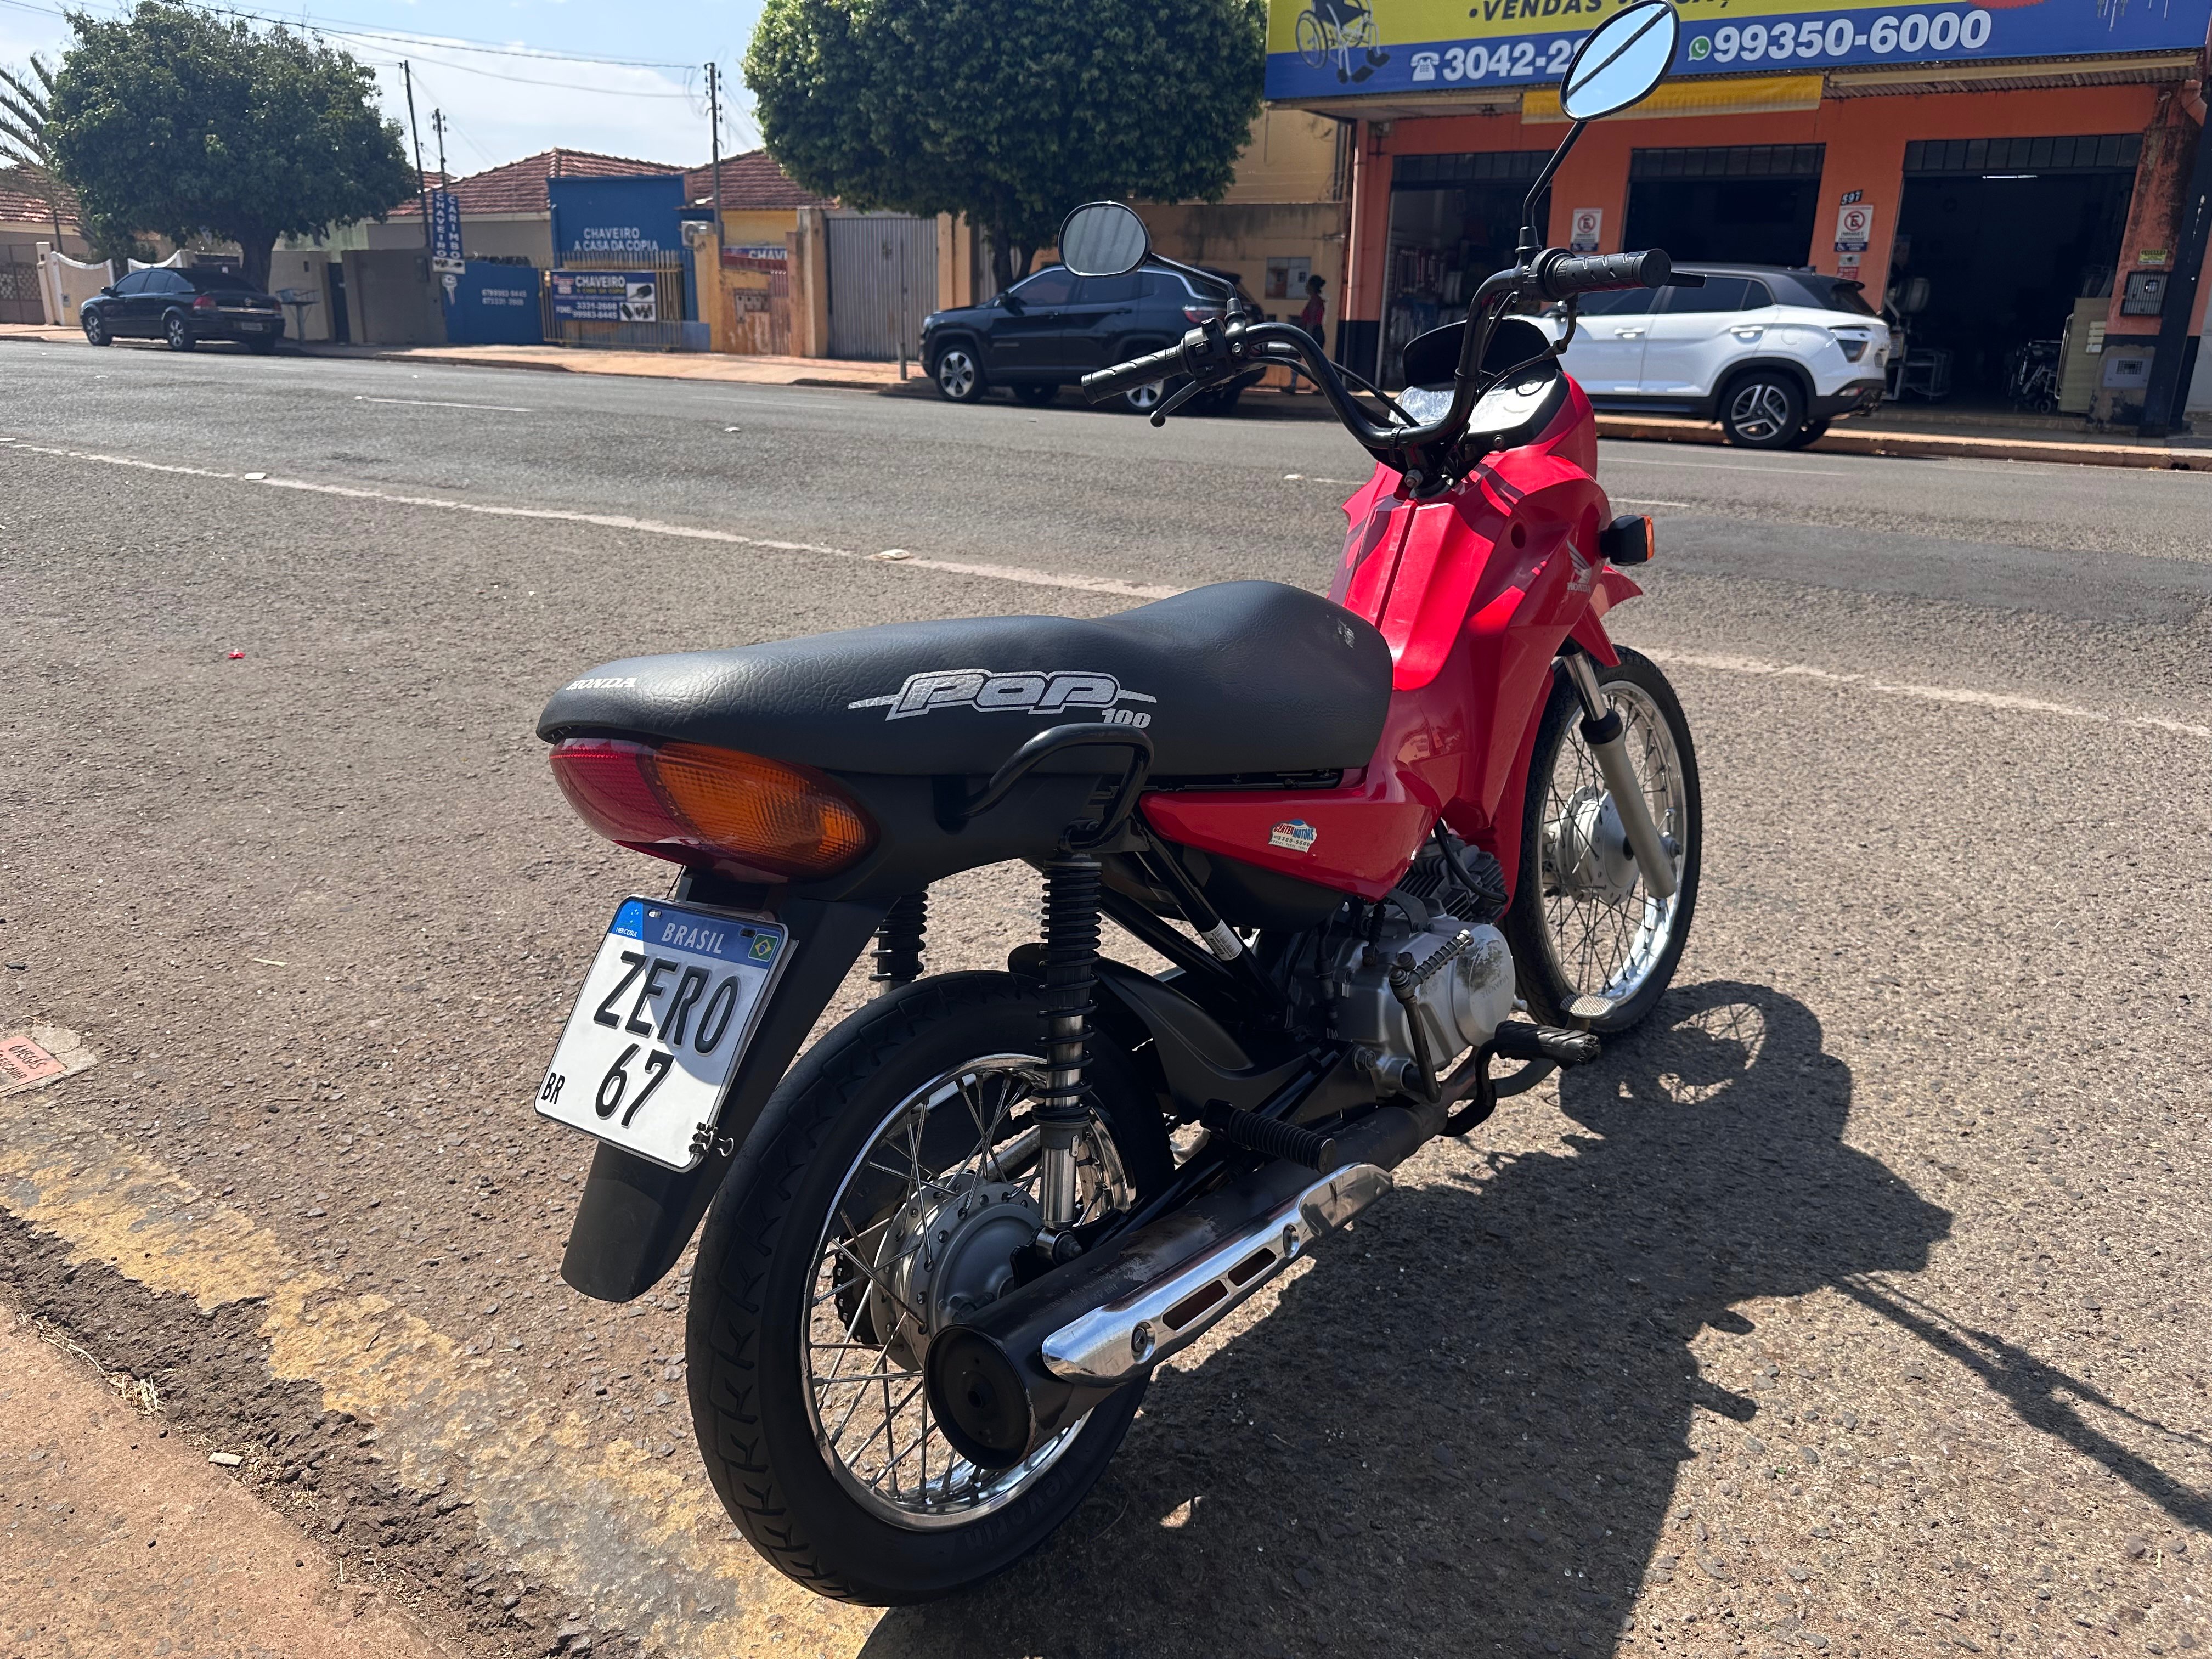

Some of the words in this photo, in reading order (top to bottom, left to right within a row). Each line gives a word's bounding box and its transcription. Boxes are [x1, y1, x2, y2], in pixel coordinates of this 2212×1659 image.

[1483, 0, 1602, 21] VENDAS
[1713, 9, 1992, 63] 99350-6000
[1442, 38, 1590, 81] 3042-2
[1841, 191, 1861, 205] 597
[436, 194, 447, 257] CHAVEIRO
[448, 196, 461, 259] CARIMBO
[583, 227, 640, 239] CHAVEIRO
[574, 241, 582, 251] A
[583, 240, 610, 251] CASA
[611, 240, 625, 251] DA
[575, 275, 625, 288] CHAVEIRO
[1567, 582, 1591, 594] HONDA
[566, 678, 636, 691] HONDA
[1102, 708, 1152, 729] 100
[1273, 823, 1295, 836] CENTER
[1292, 828, 1314, 841] MOTORS
[616, 927, 638, 938] MERCOSUL
[661, 922, 724, 955] BRASIL
[593, 950, 740, 1054] ZERO
[541, 1073, 565, 1104] BR
[595, 1043, 675, 1127] 67
